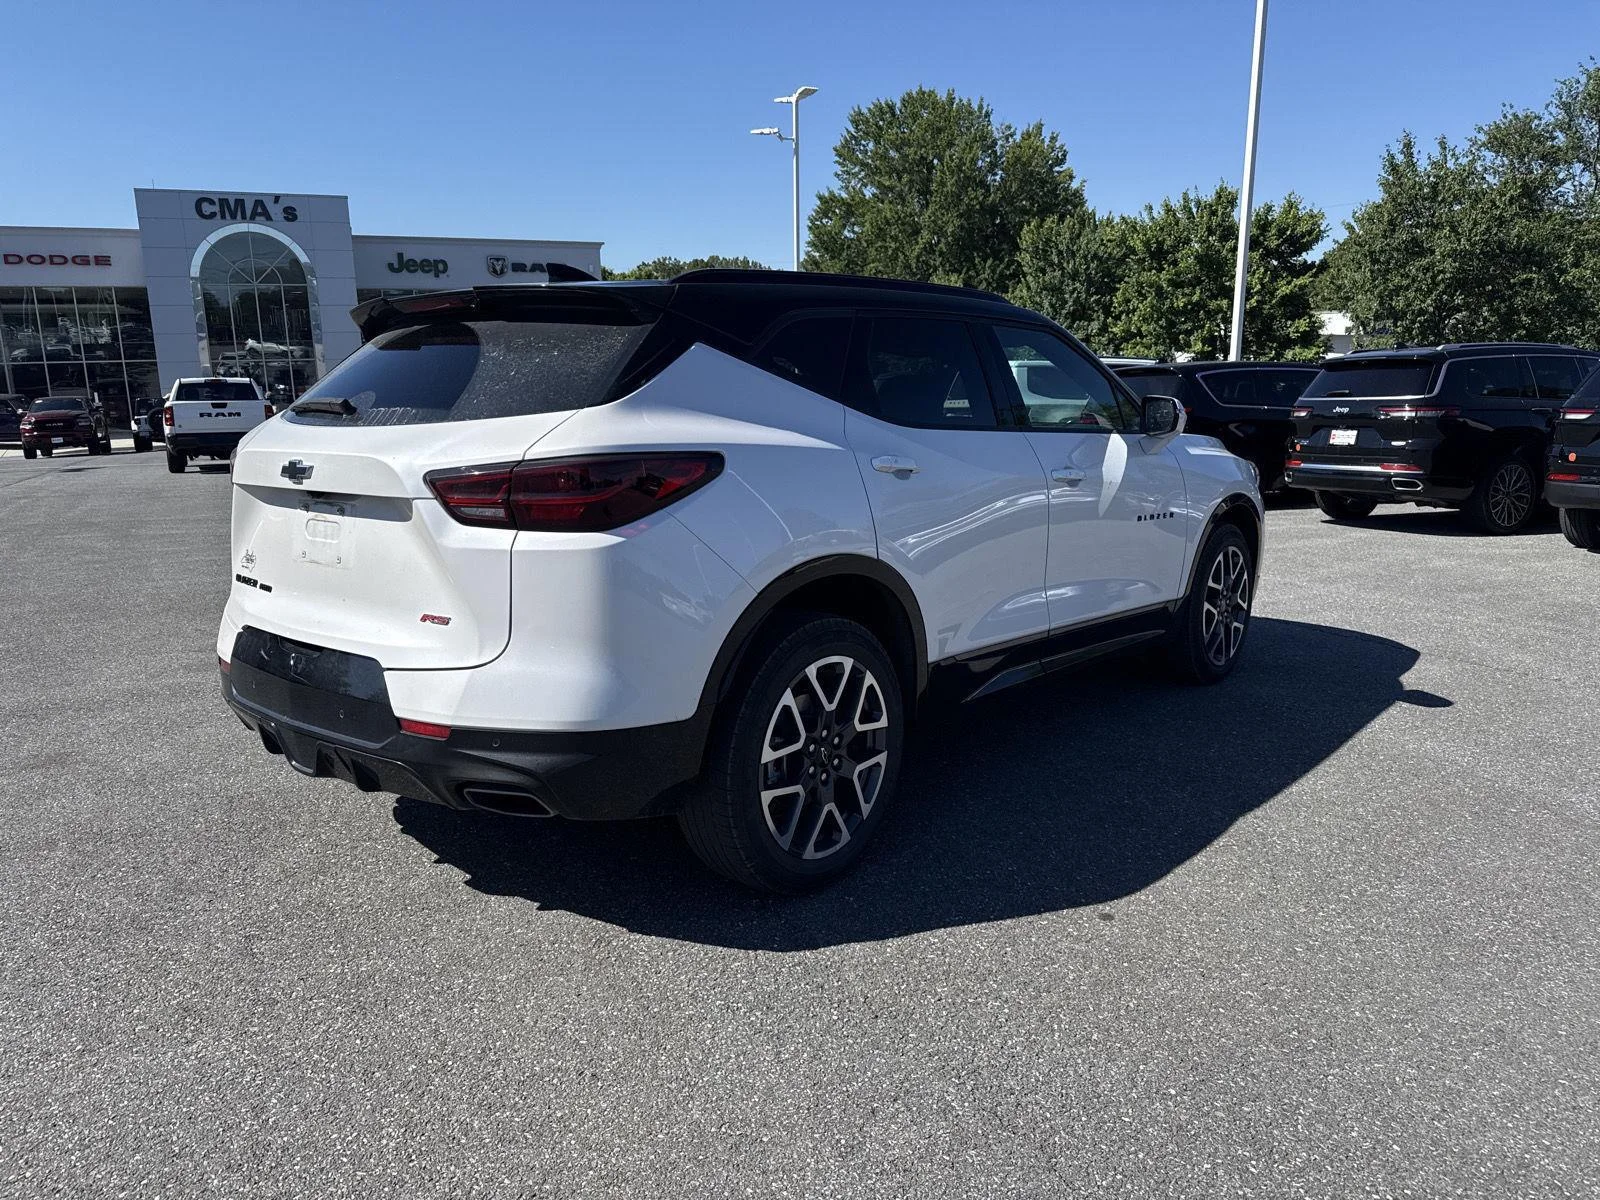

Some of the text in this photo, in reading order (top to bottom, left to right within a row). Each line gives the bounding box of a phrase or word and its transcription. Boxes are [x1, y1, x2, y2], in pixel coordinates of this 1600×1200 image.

[194, 195, 298, 222] CMA's
[3, 253, 112, 266] DODGE
[387, 252, 449, 278] Jeep
[511, 262, 547, 273] RA
[1332, 406, 1349, 414] Jeep
[1136, 511, 1174, 522] BLAZER
[420, 613, 451, 626] RS
